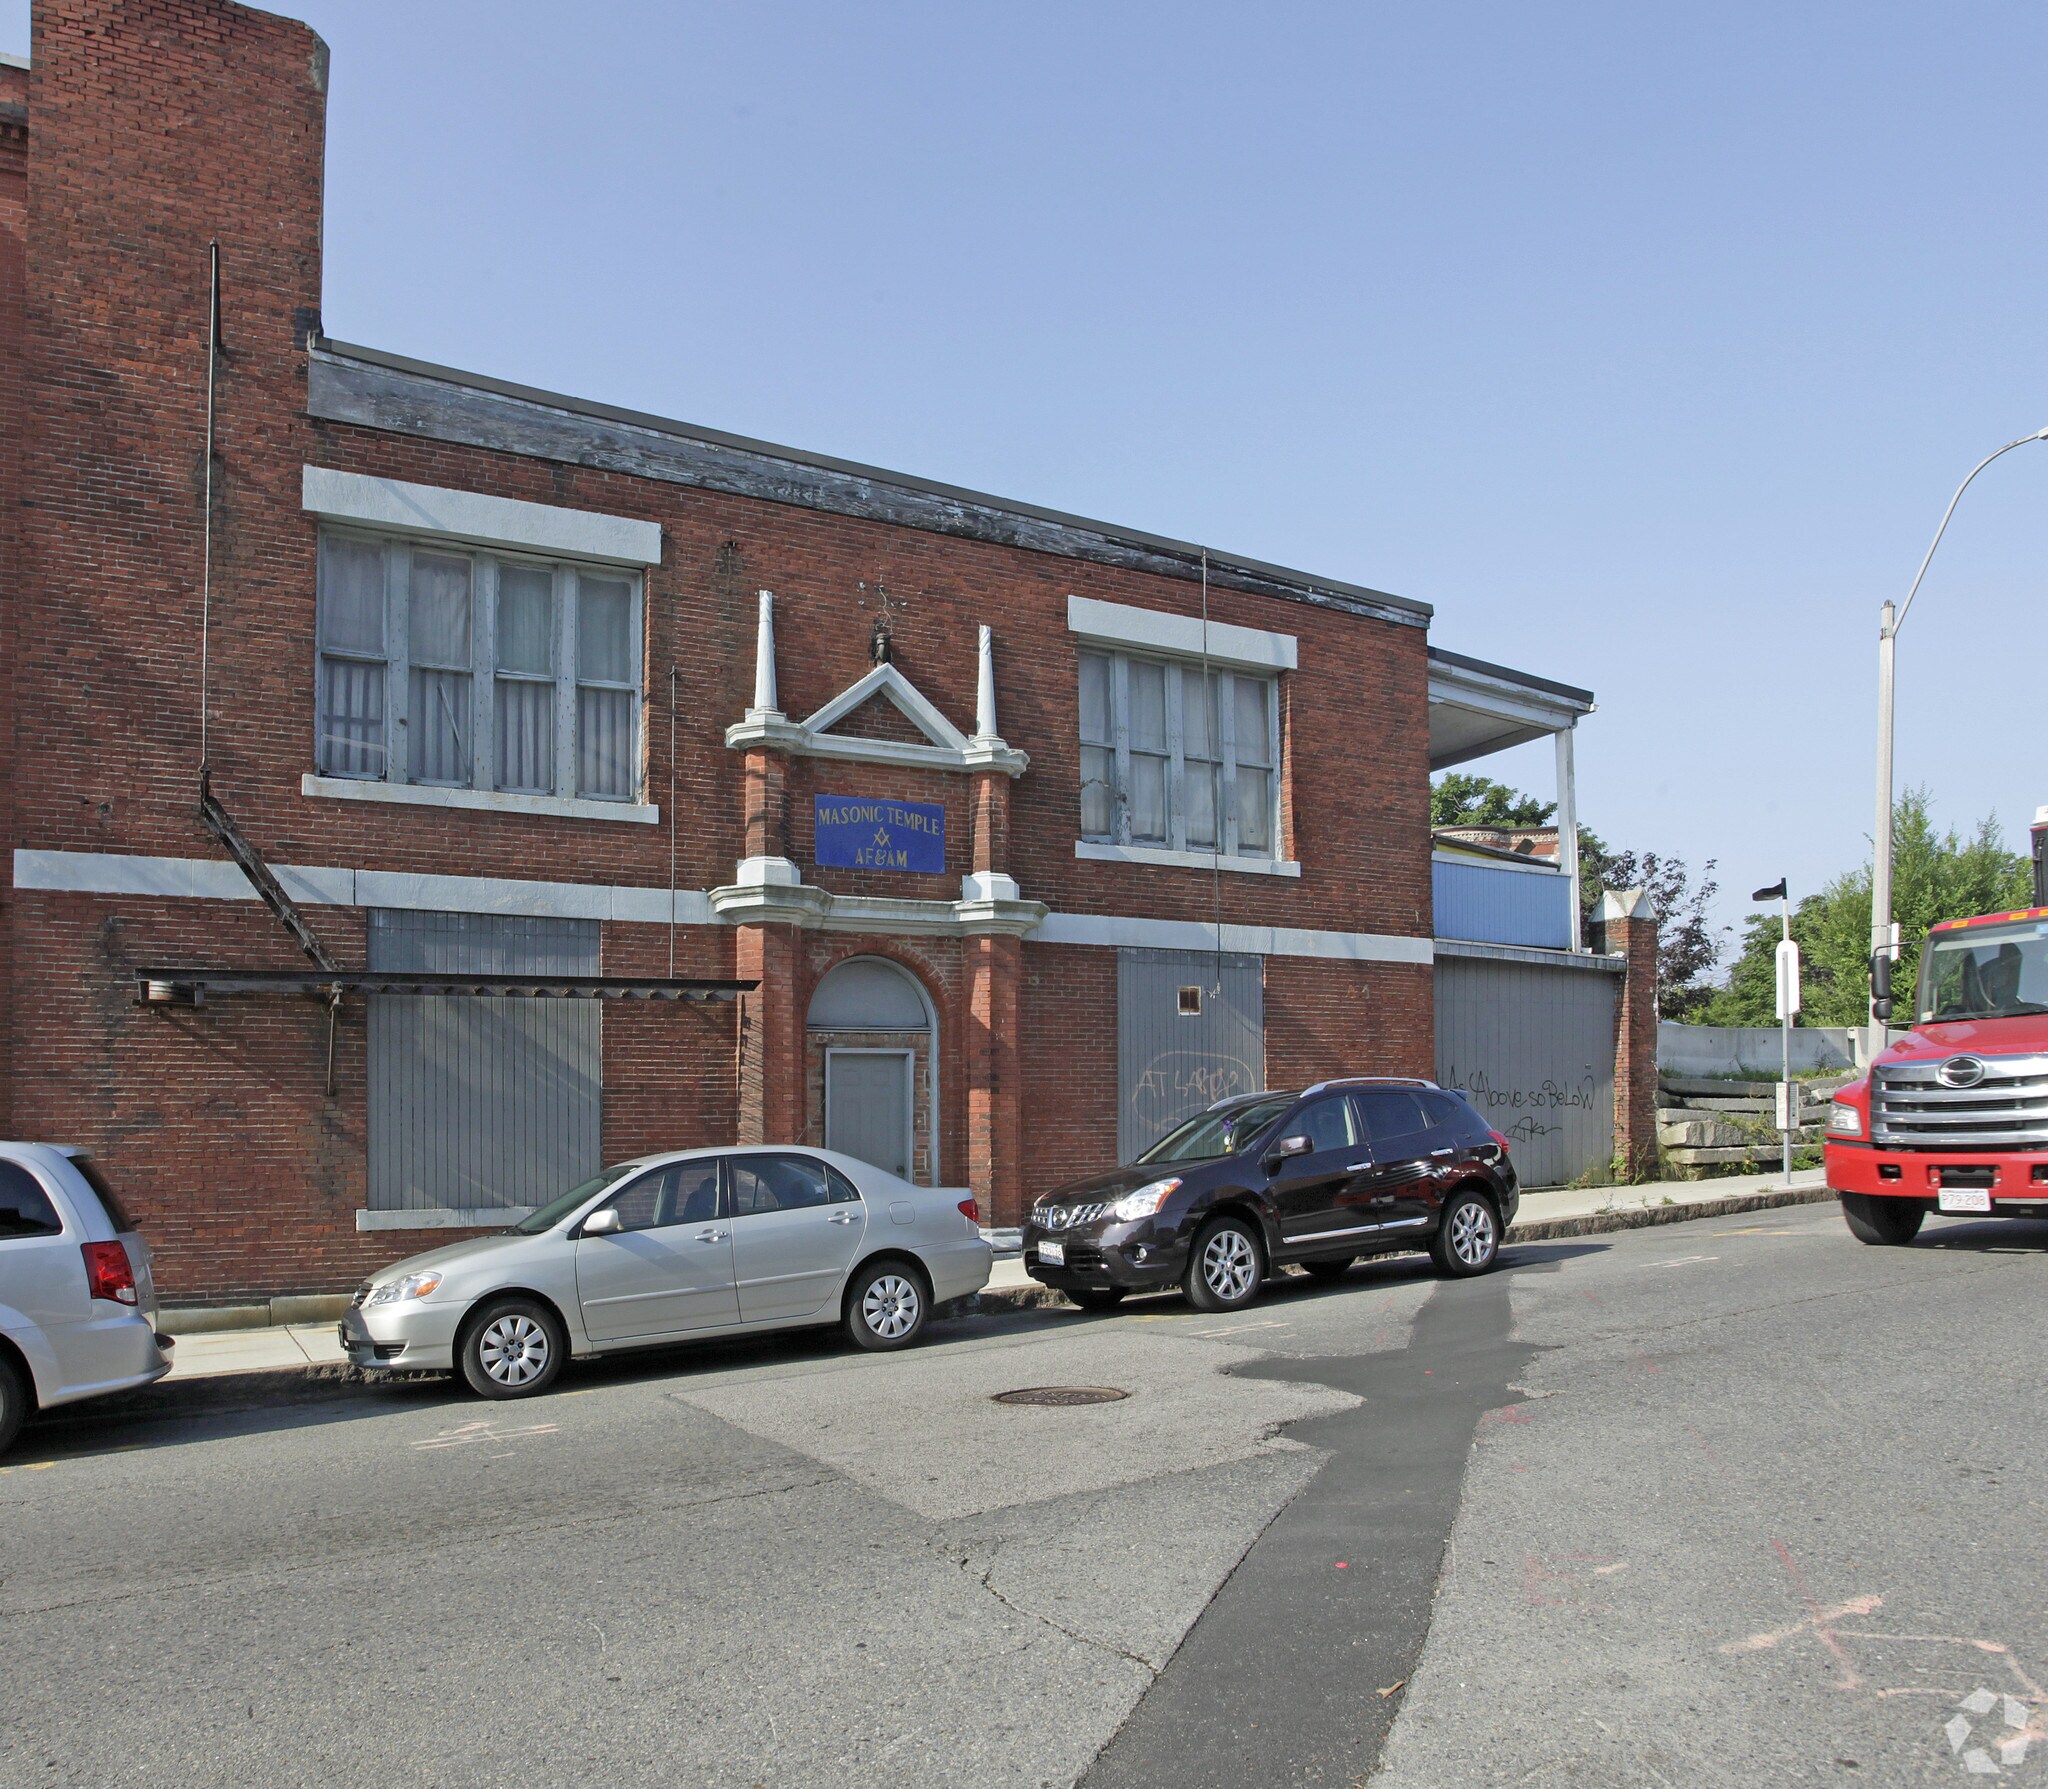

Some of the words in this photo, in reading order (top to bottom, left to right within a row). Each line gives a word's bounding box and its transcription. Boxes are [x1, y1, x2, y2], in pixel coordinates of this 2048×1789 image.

[818, 806, 884, 826] MASONIC
[887, 807, 940, 836] TEMPLE
[855, 848, 908, 868] AF&AM
